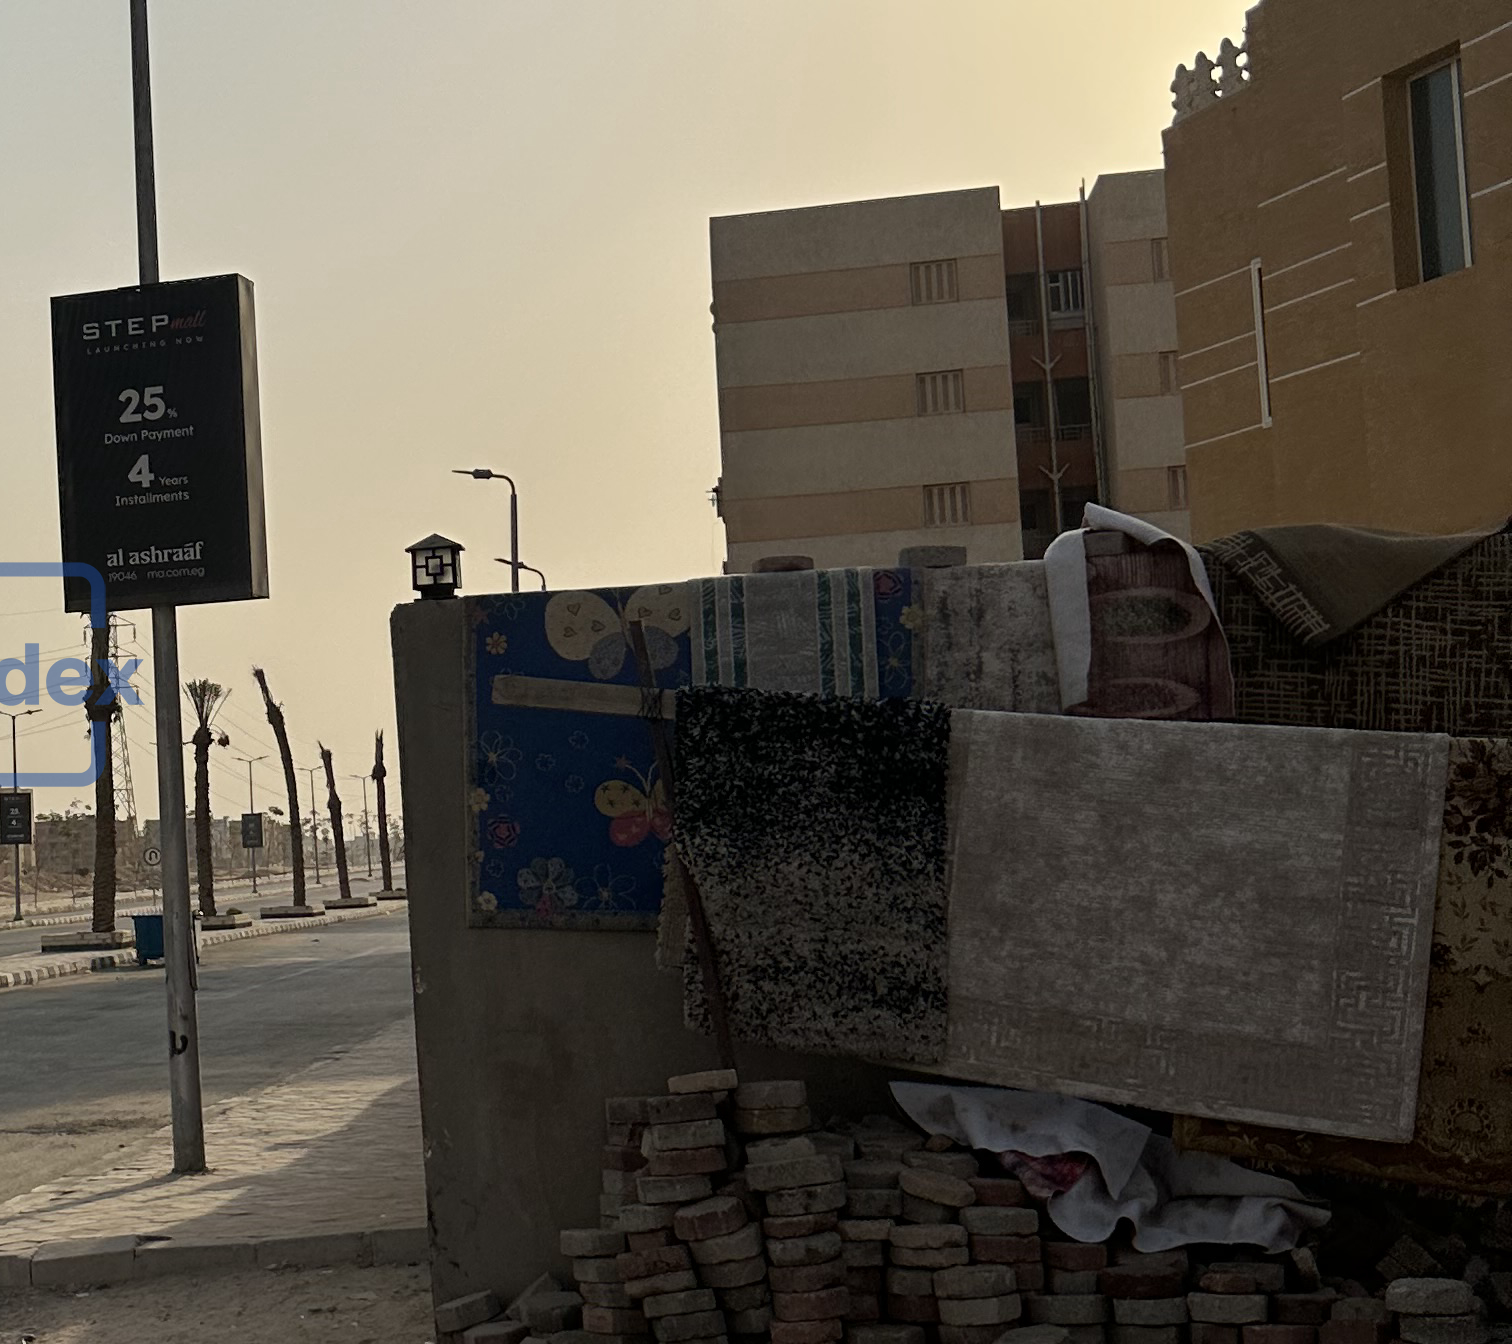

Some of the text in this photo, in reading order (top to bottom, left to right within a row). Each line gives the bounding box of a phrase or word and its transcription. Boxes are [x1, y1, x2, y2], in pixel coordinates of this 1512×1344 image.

[82, 309, 207, 341] STEP mall
[86, 335, 204, 355] LAUNCHING NOW
[104, 424, 195, 445] Down Payment
[127, 454, 189, 488] 4 Years
[115, 490, 190, 507] Installments
[106, 548, 124, 567] al
